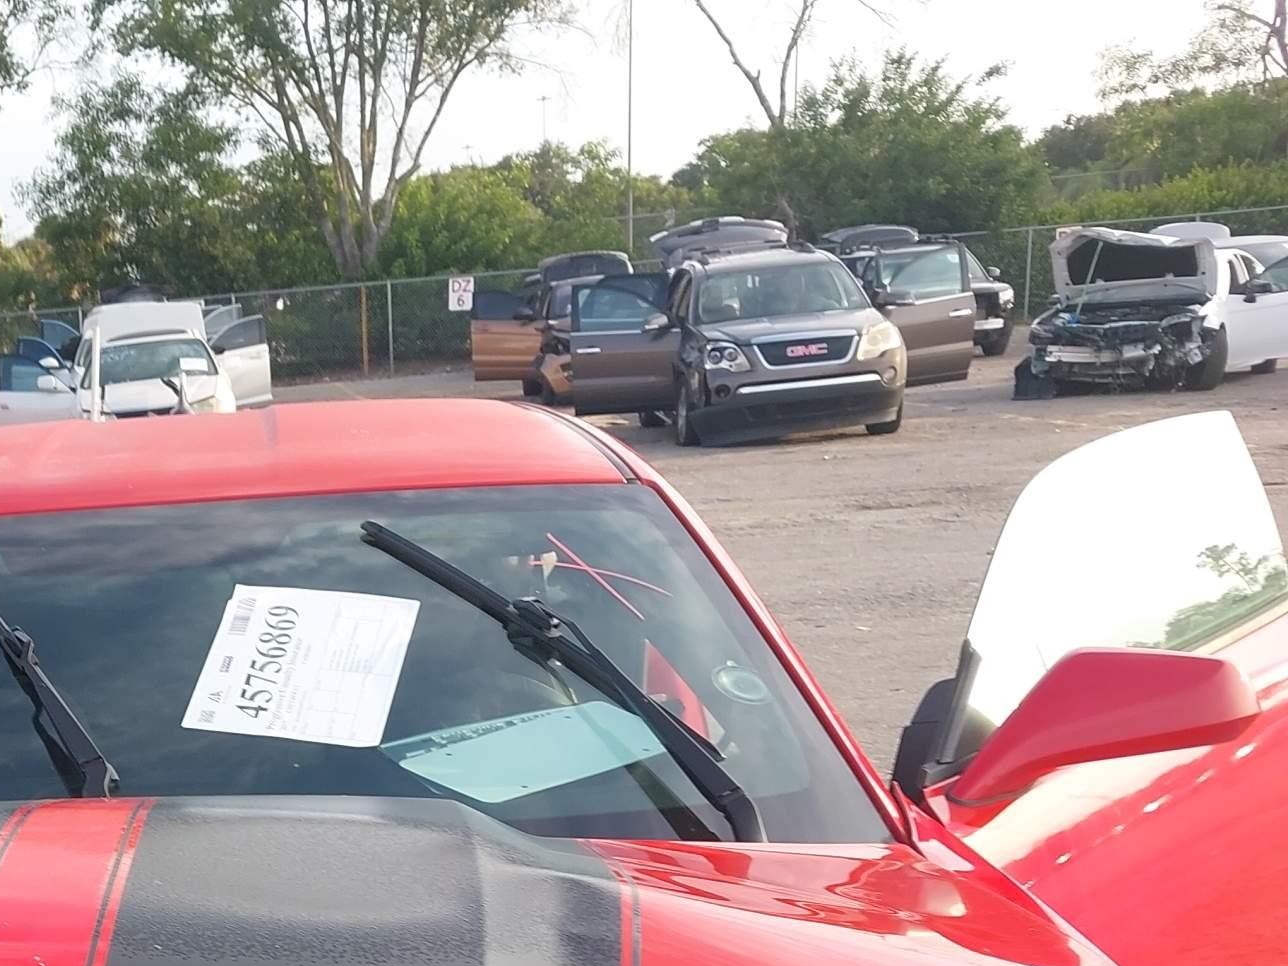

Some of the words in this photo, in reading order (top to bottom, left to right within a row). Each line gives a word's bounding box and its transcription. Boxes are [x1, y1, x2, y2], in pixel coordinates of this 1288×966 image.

[452, 280, 472, 293] DZ
[457, 294, 465, 308] 6
[786, 343, 828, 357] GMC
[235, 605, 300, 719] 45756869
